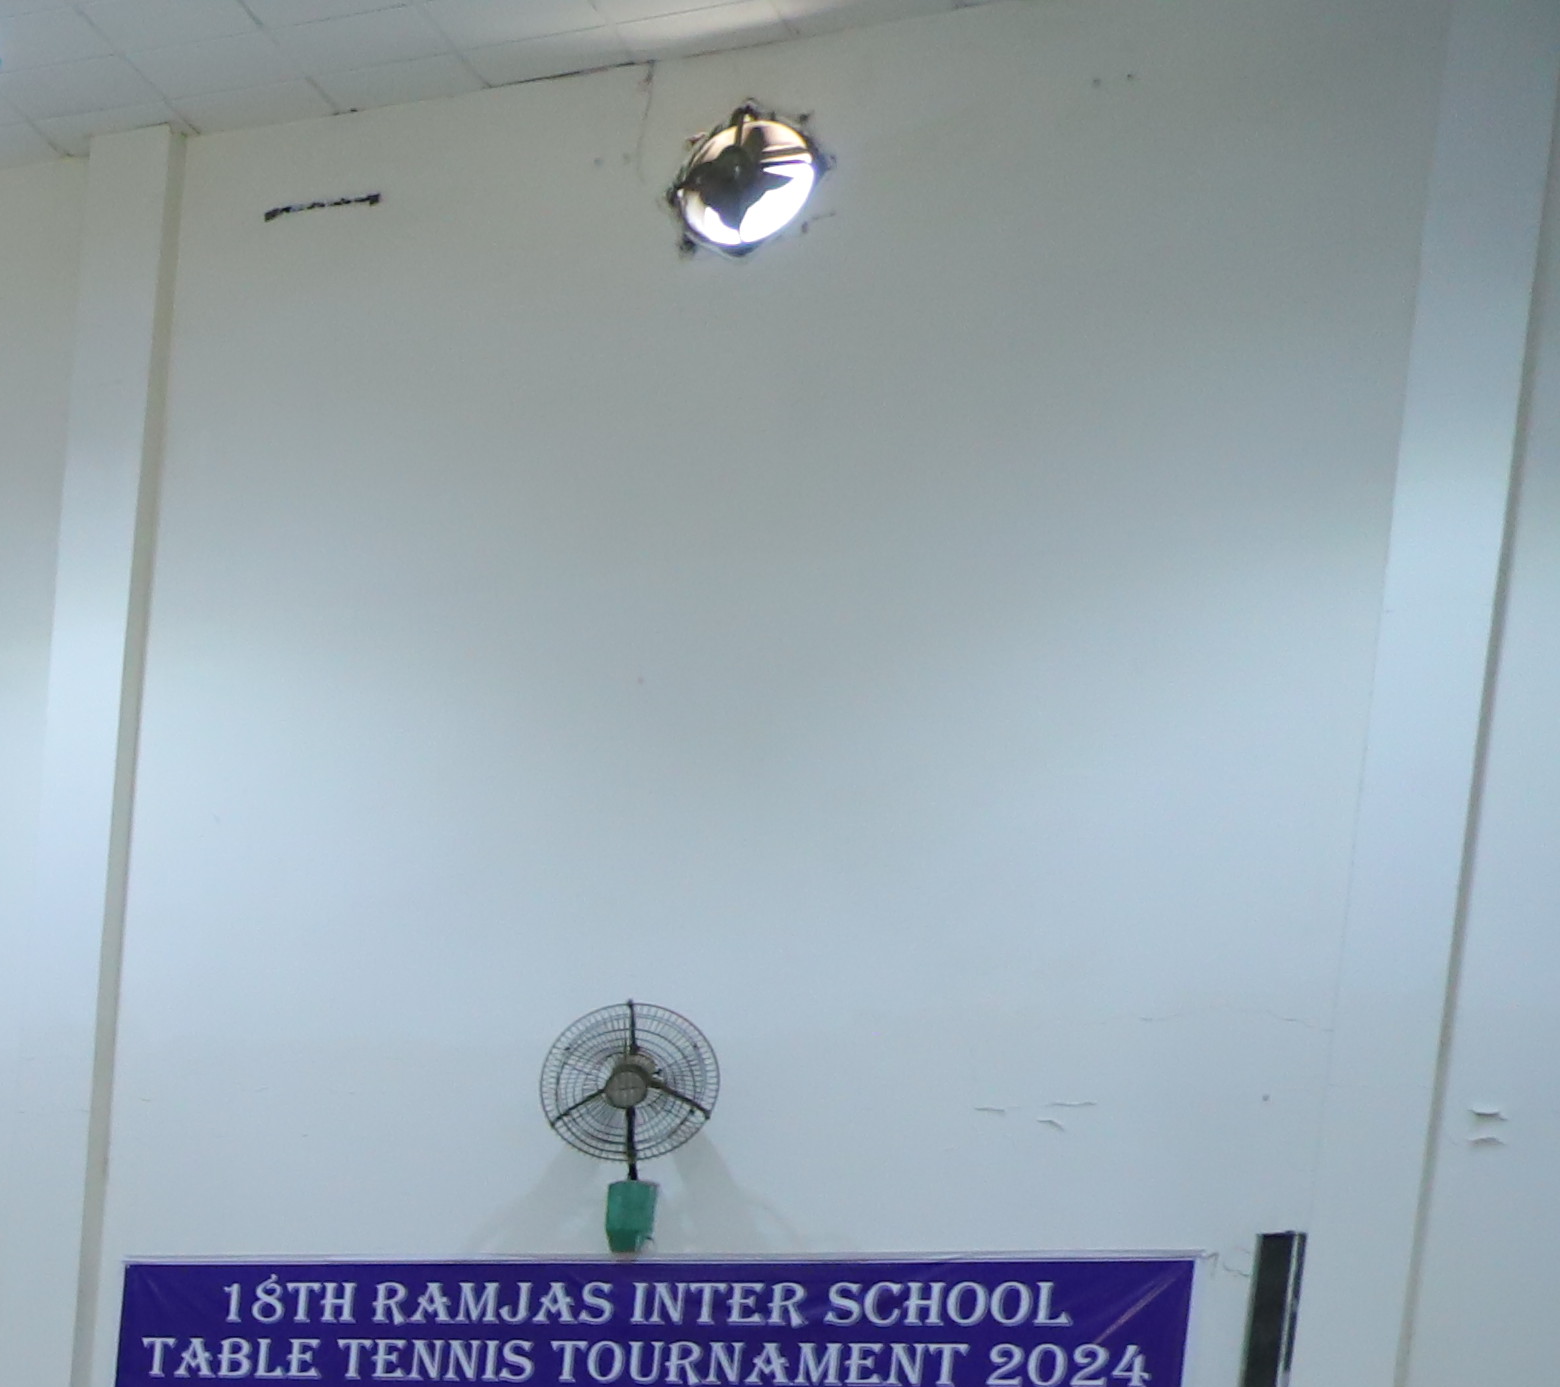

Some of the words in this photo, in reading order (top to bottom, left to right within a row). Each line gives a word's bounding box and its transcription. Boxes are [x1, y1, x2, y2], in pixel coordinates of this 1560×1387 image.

[224, 1273, 357, 1324] 18TH
[372, 1281, 615, 1327] RAMJAS
[629, 1281, 808, 1329] INTER
[823, 1280, 1073, 1327] SCHOOL
[141, 1336, 321, 1380] TABLE
[337, 1338, 535, 1383] TENNIS
[550, 1339, 969, 1387] TOURNAMENT
